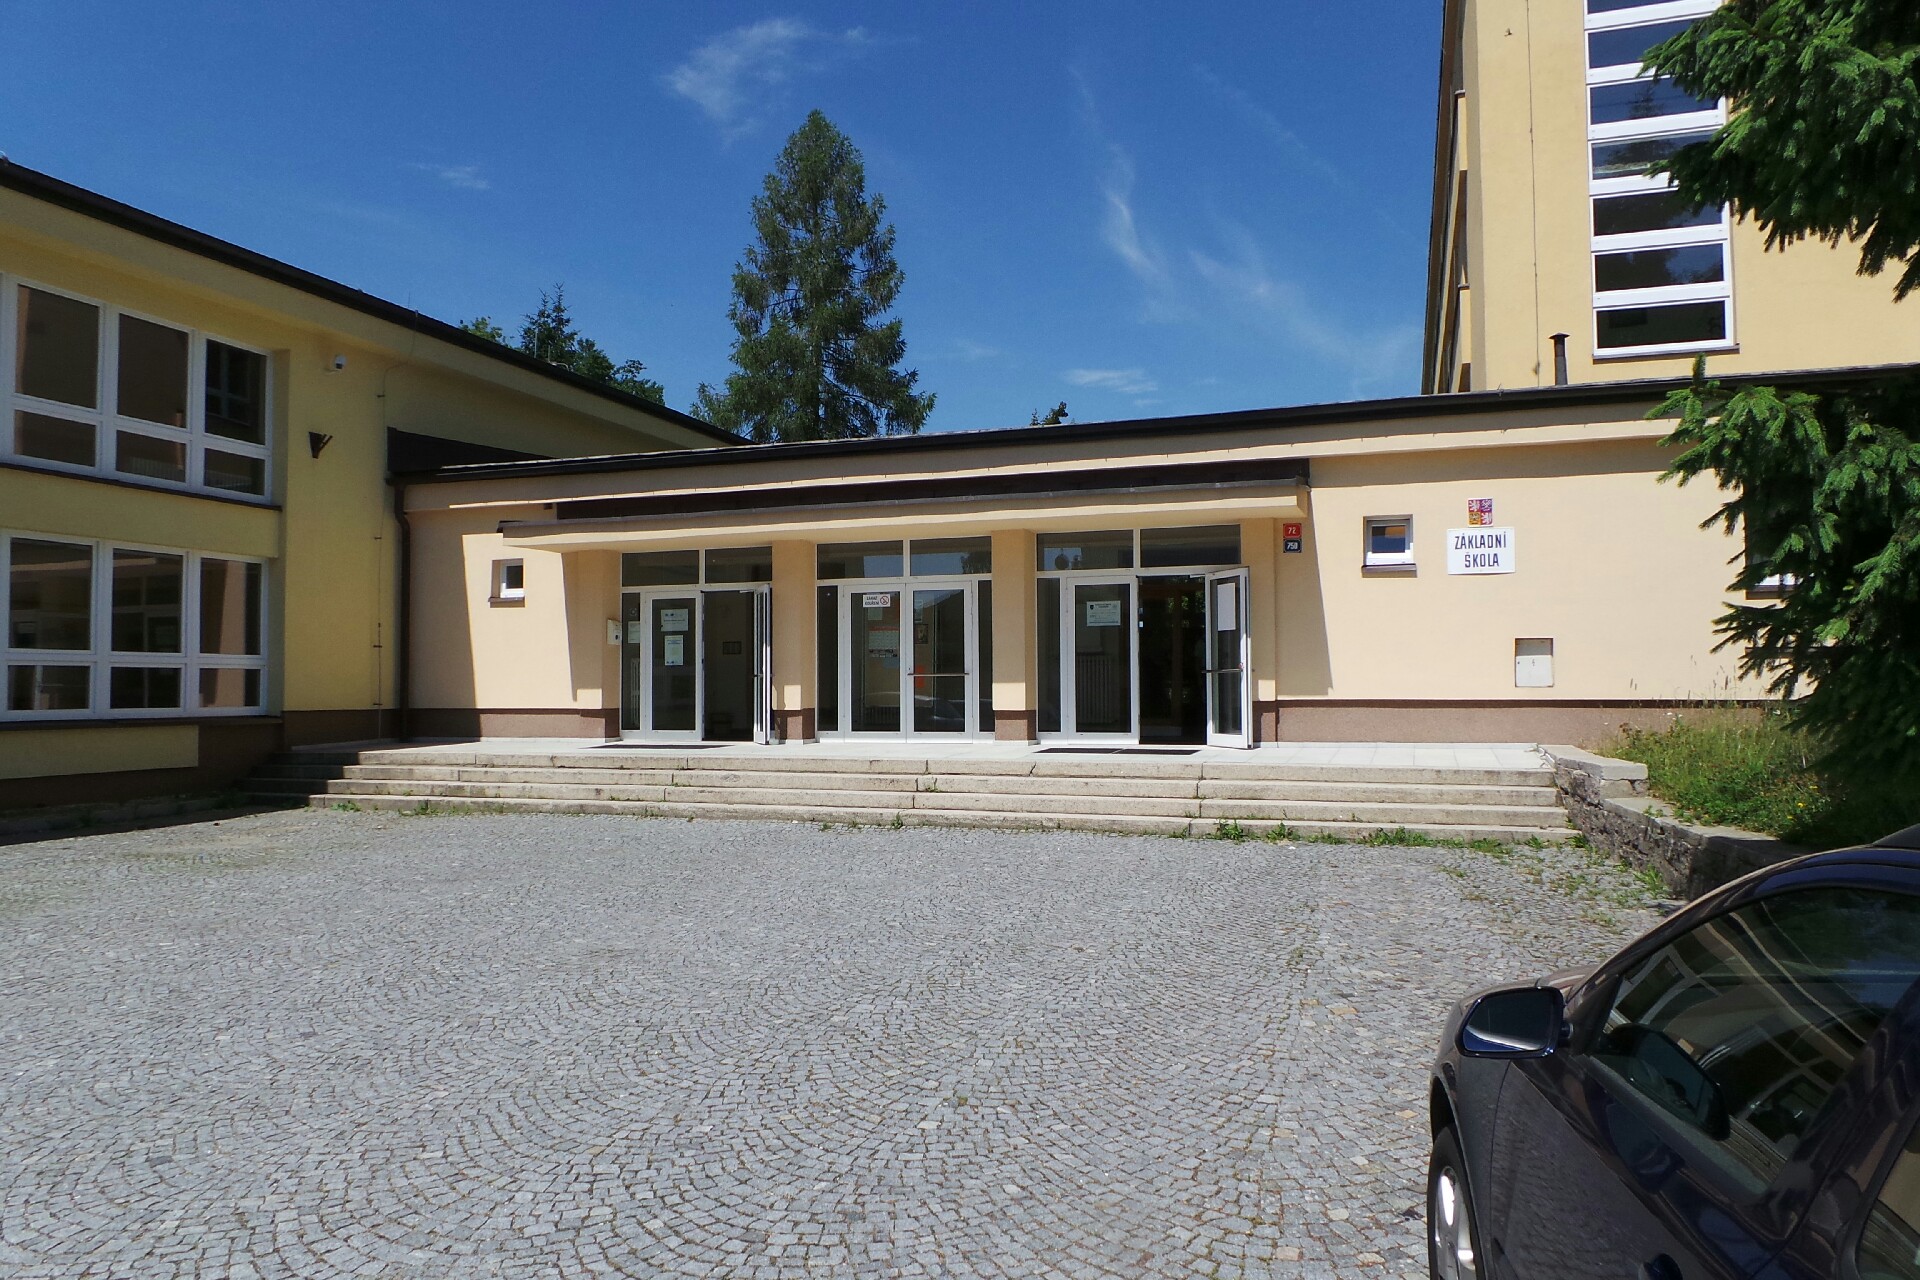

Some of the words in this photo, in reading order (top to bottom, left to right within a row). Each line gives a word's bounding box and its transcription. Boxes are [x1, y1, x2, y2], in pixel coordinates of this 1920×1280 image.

[1288, 526, 1296, 535] 72
[1455, 531, 1507, 550] ZÁKLADNÍ
[1464, 551, 1500, 568] ŠKOLA
